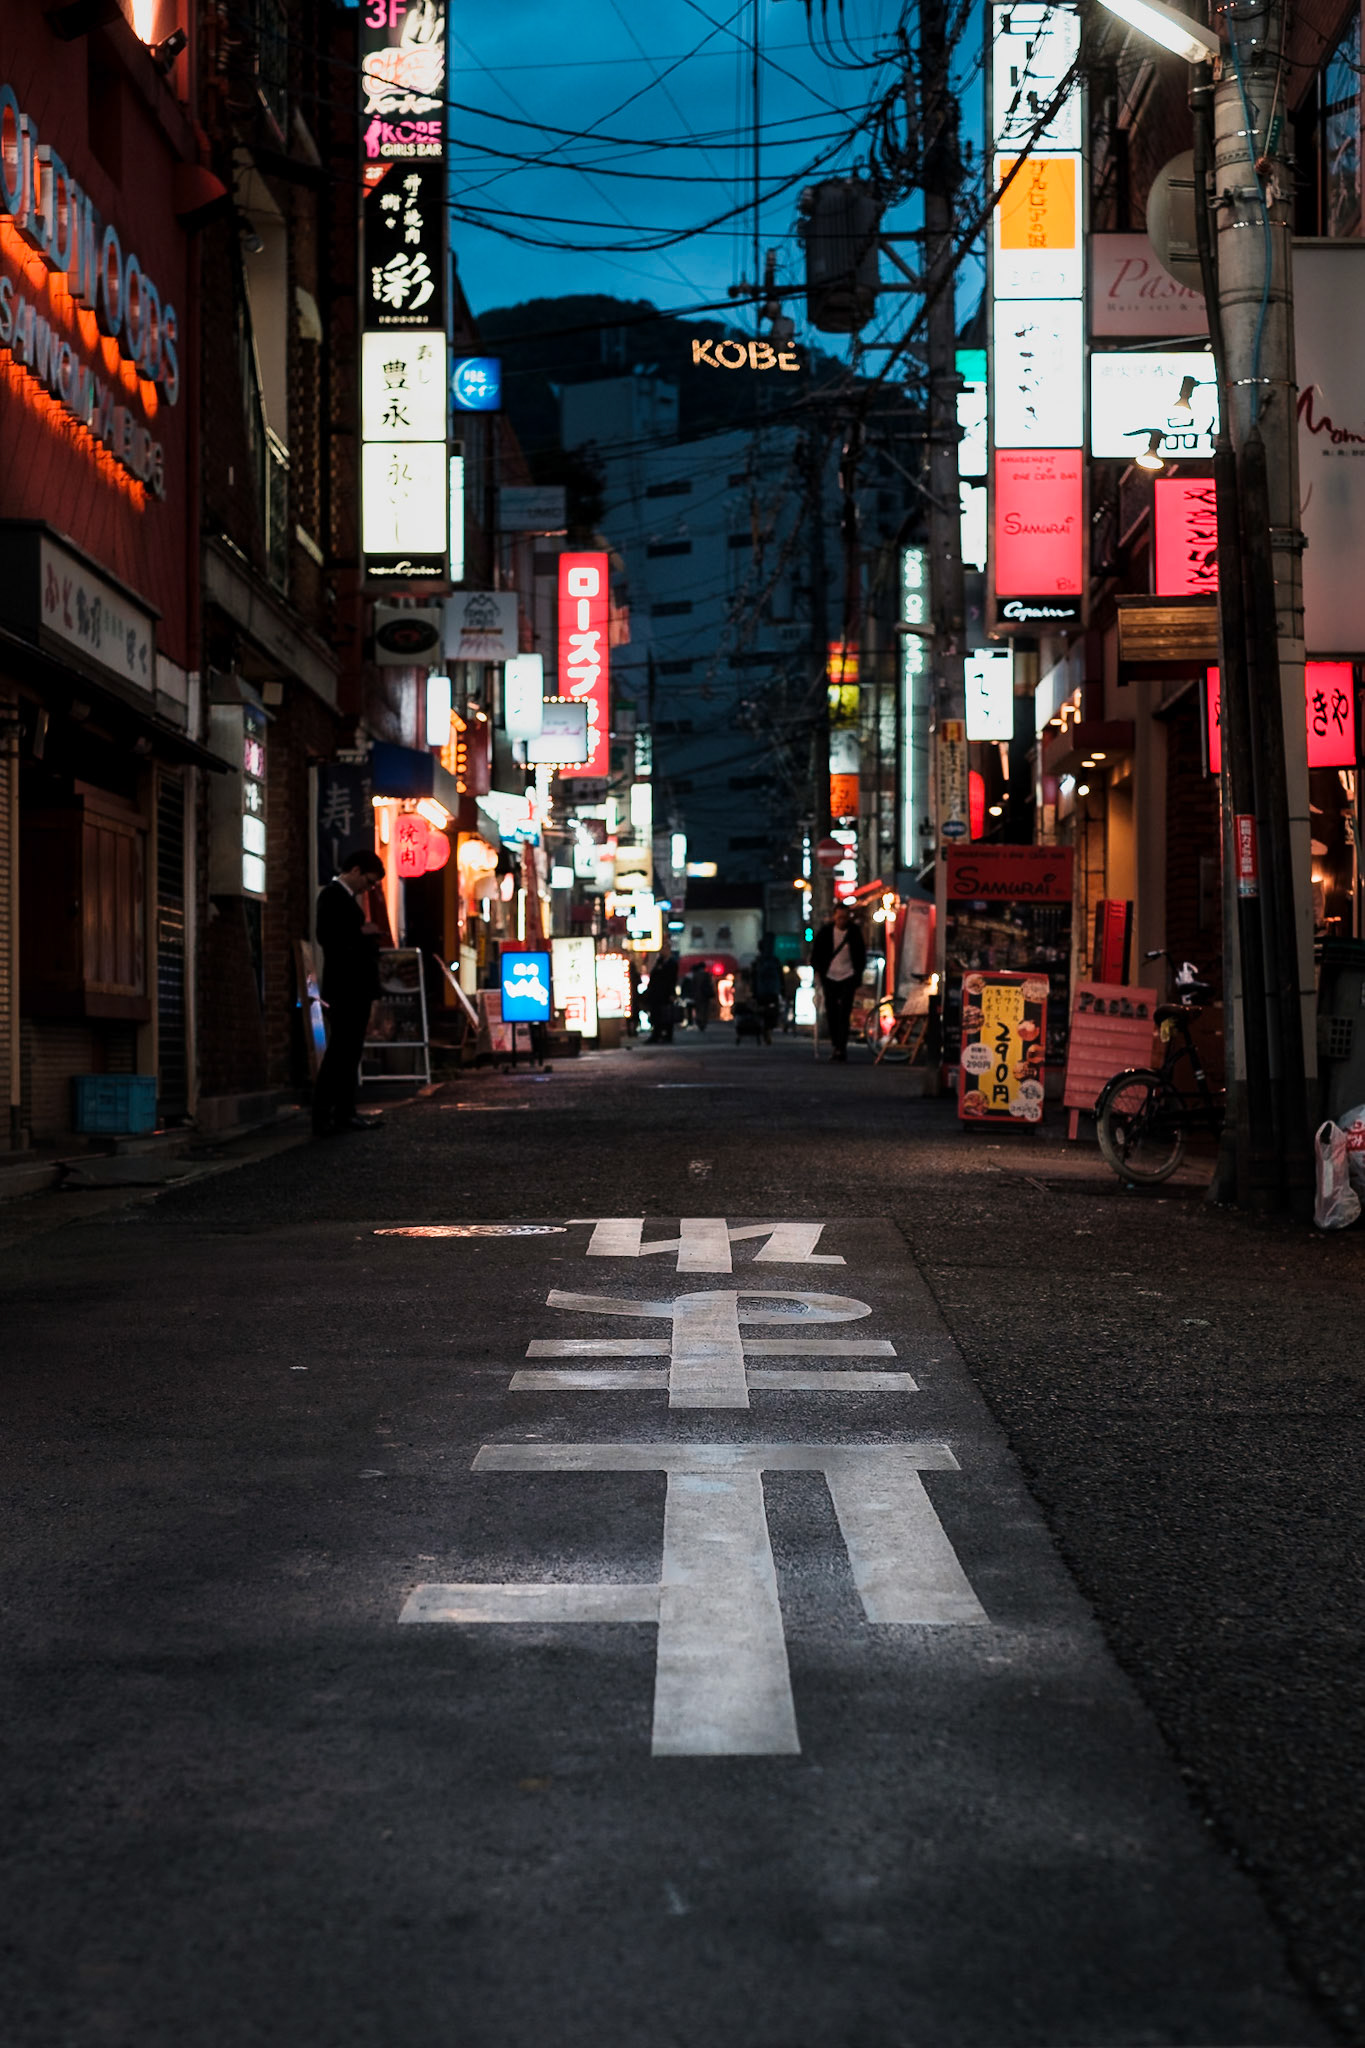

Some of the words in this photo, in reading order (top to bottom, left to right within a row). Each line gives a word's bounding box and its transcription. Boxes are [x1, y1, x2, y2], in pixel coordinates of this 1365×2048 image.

[365, 0, 408, 29] 3F
[381, 143, 416, 158] GIRLS
[417, 143, 443, 157] BAR
[381, 252, 435, 311] 彩
[692, 339, 801, 371] KOBE
[382, 359, 411, 428] 豊永
[399, 824, 419, 866] 焼肉
[993, 1022, 1012, 1104] 290円
